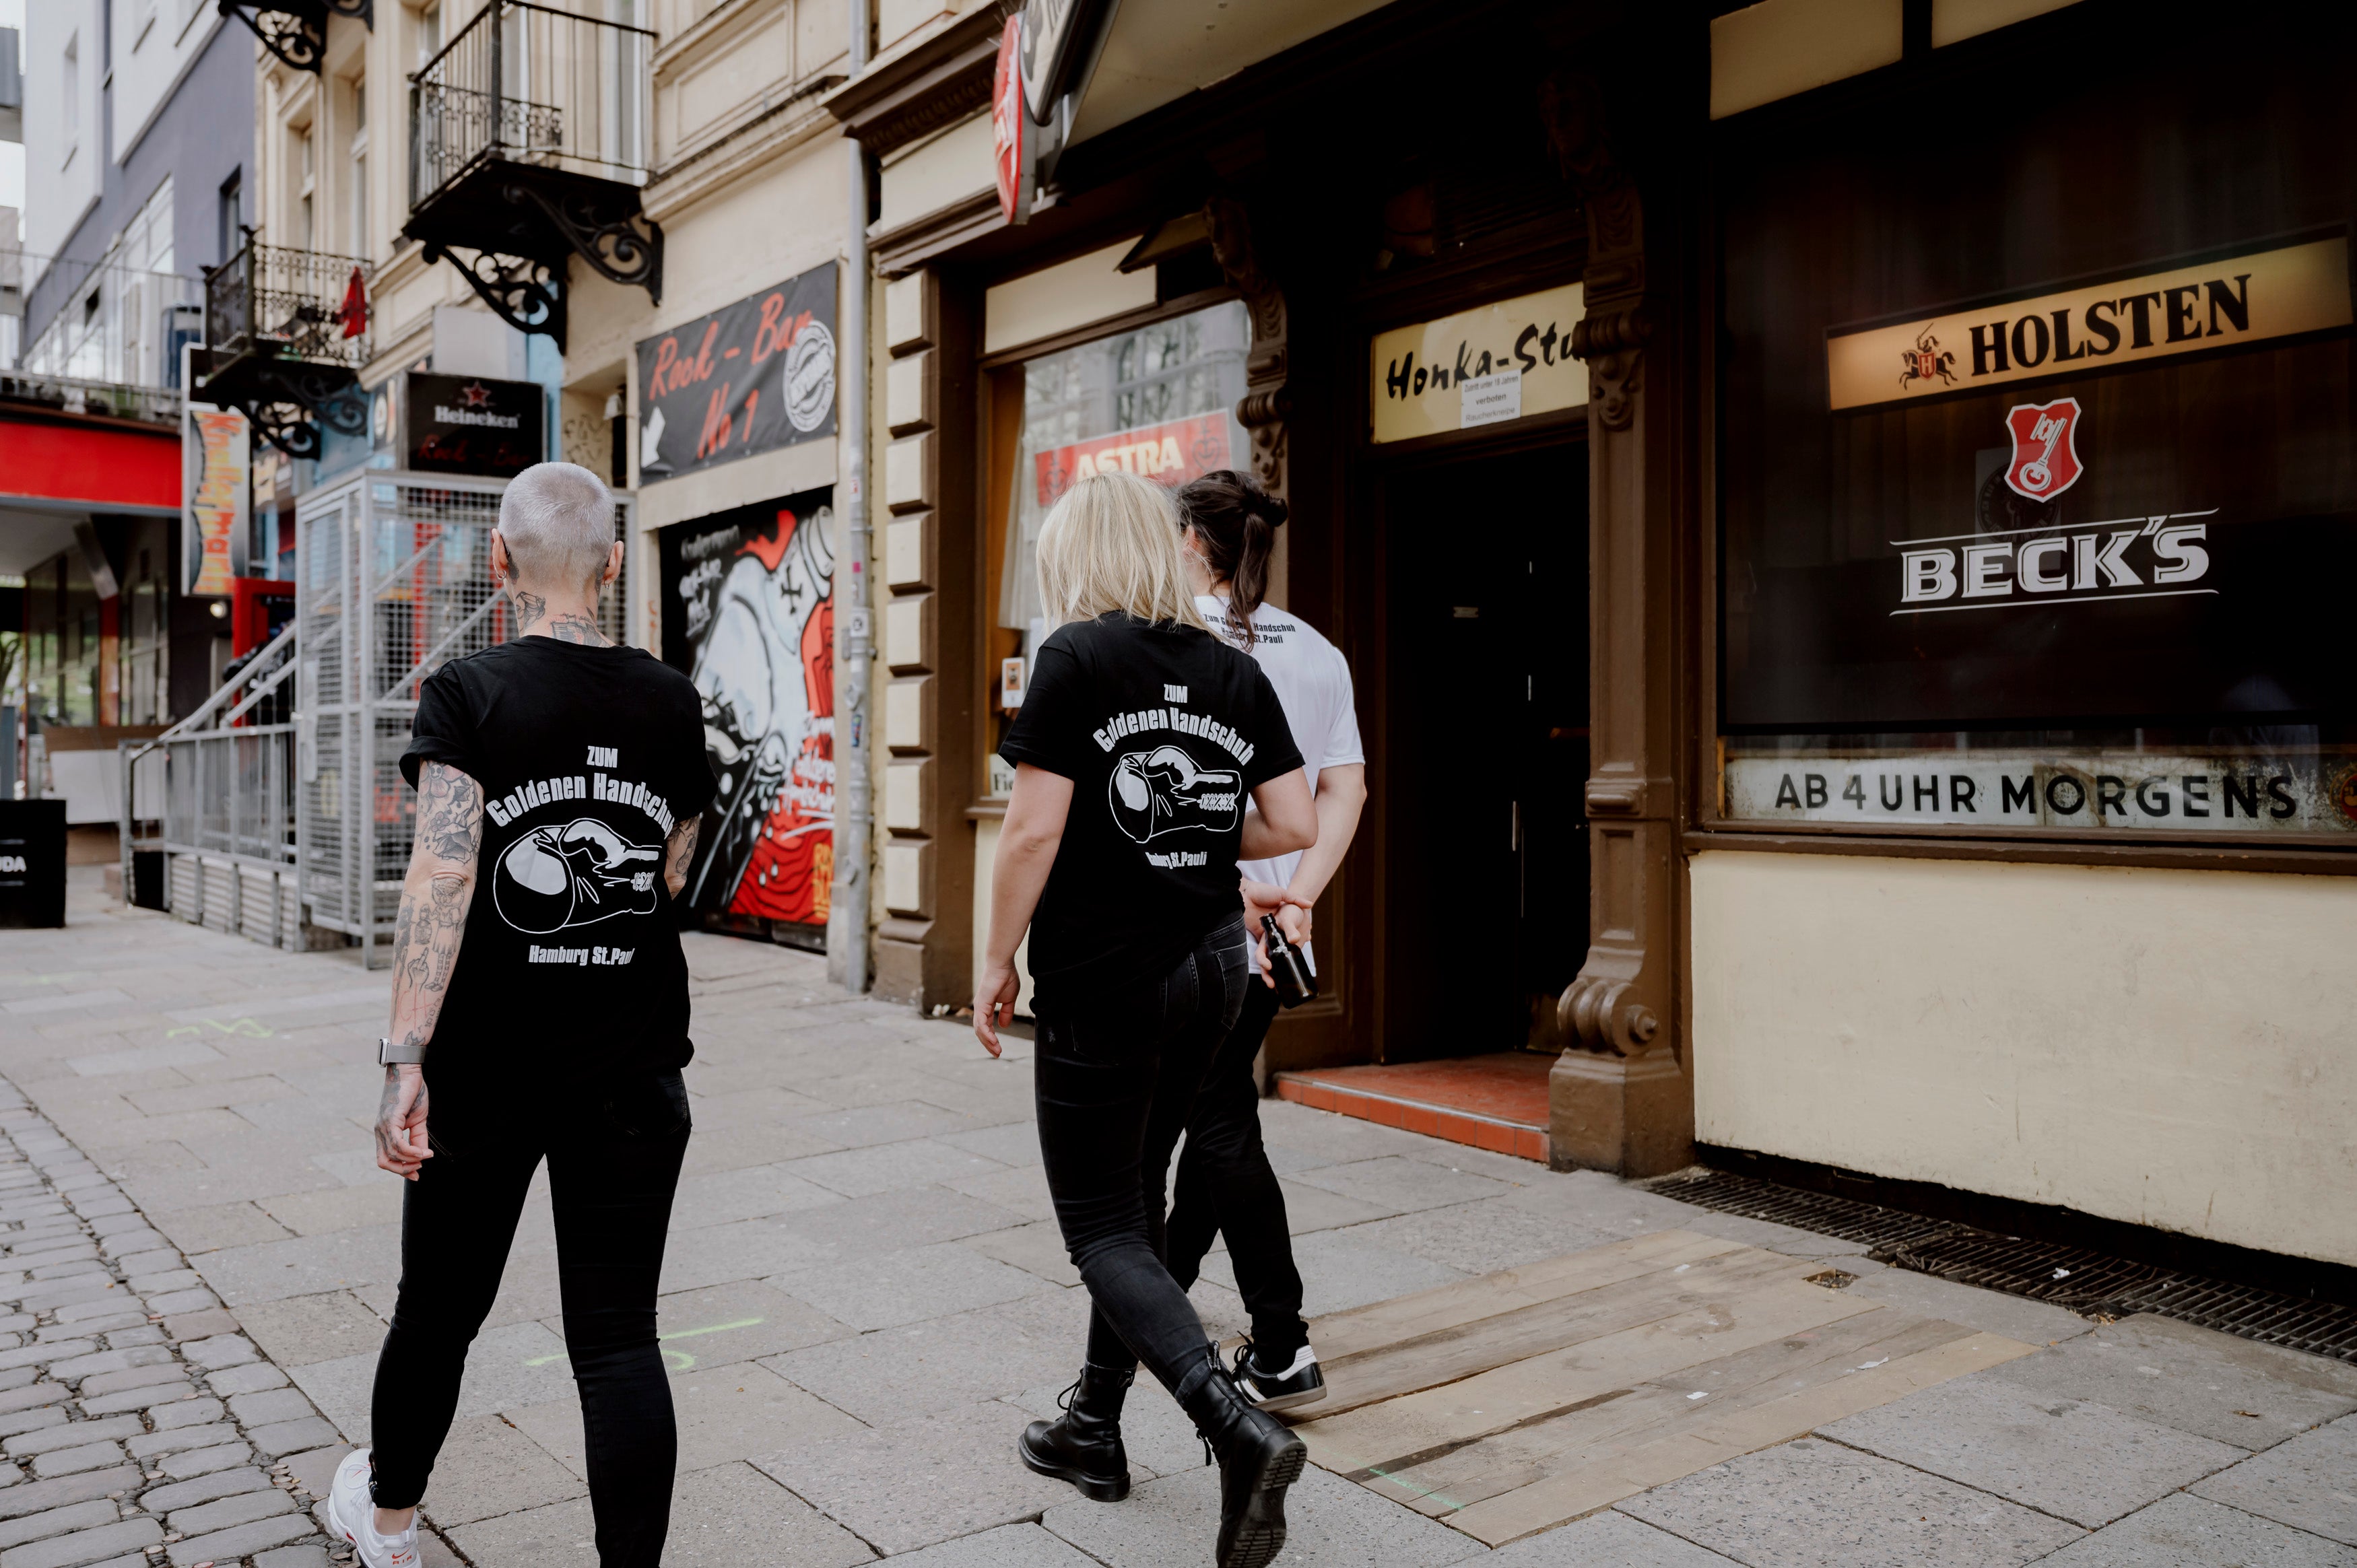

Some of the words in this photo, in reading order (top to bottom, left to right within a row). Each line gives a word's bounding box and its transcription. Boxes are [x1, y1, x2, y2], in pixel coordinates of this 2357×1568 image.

[751, 292, 814, 366] Bar
[1969, 274, 2252, 377] HOLSTEN
[1480, 381, 1493, 389] unter
[1494, 378, 1500, 386] 18
[1501, 376, 1519, 385] Jahren
[1921, 355, 1933, 375] H
[434, 405, 519, 429] Heineken
[697, 382, 733, 460] No
[1465, 407, 1515, 422] Raucherkneipe
[1475, 394, 1506, 405] verboten
[1076, 435, 1185, 482] ASTRA
[1900, 516, 2211, 603] BECK'S
[1253, 622, 1296, 633] Handschuh
[1170, 706, 1255, 766] Handschuh
[486, 776, 586, 827] Goldenen
[1775, 773, 1829, 810] AB
[1842, 774, 1867, 810] 4
[1879, 774, 1977, 814] UHR
[2002, 774, 2298, 819] MORGENS
[529, 945, 589, 966] Hamburg
